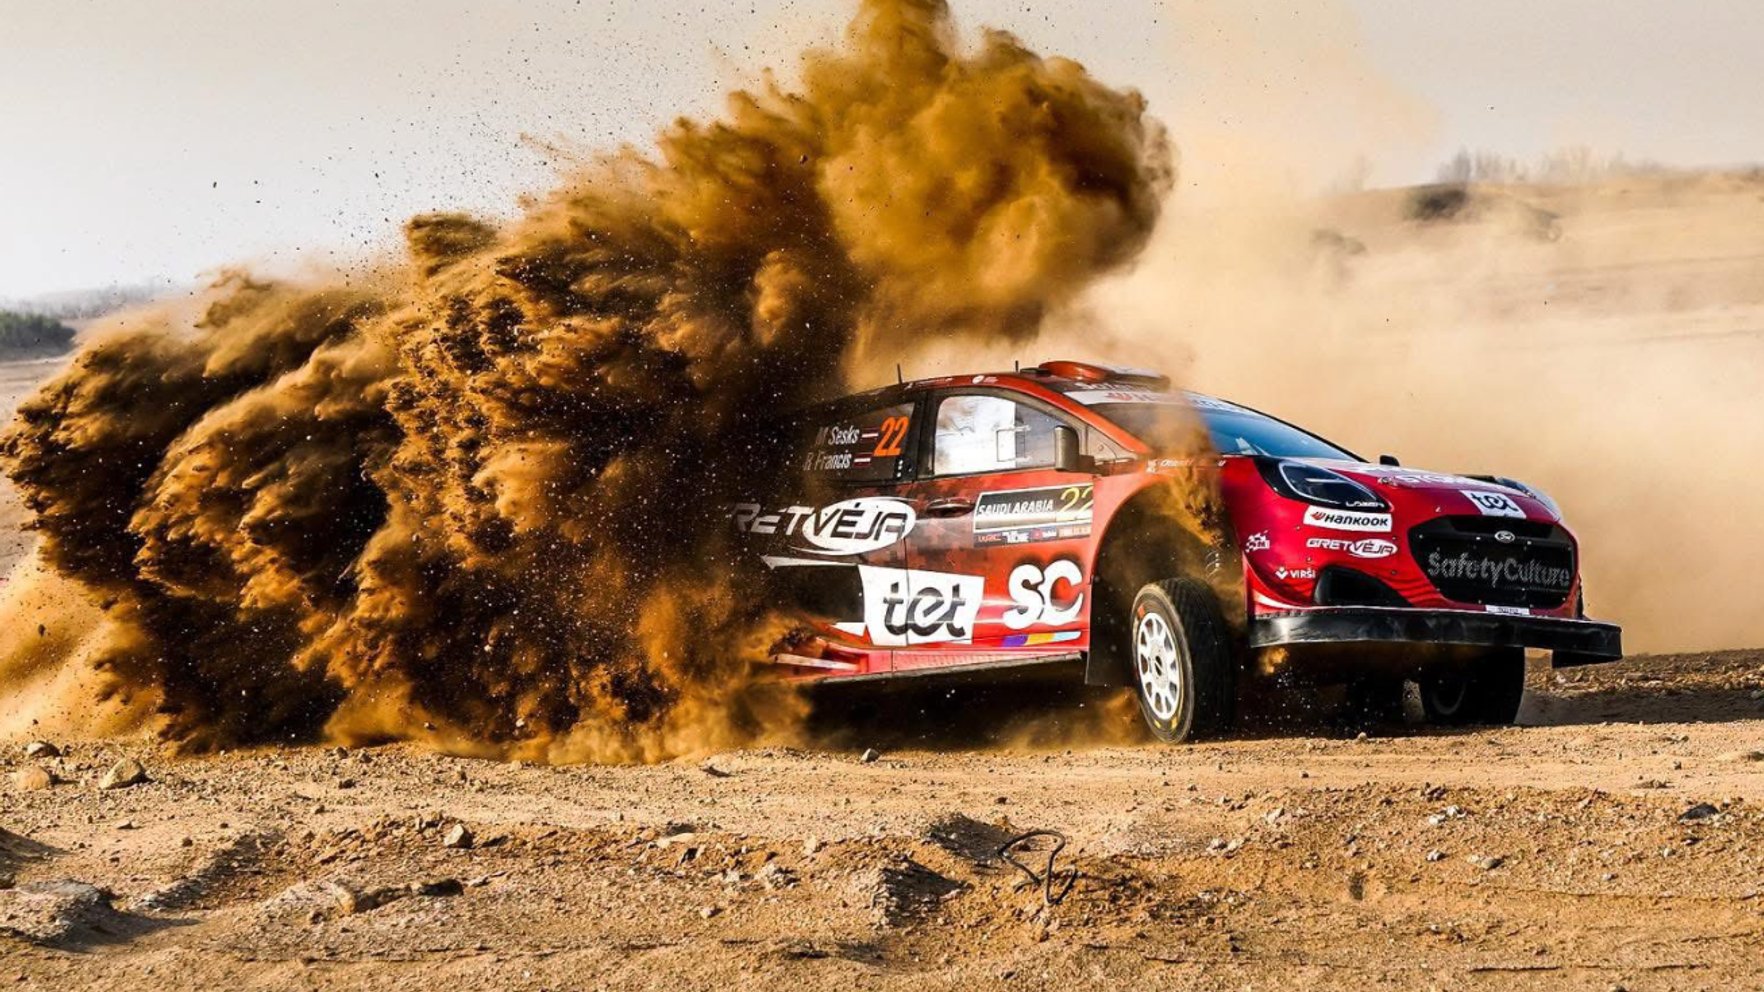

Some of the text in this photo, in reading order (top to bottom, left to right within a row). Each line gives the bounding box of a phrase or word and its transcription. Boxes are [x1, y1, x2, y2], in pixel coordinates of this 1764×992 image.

[828, 425, 860, 445] Sesks
[873, 416, 909, 456] 22
[814, 449, 852, 469] Francis
[978, 499, 1054, 516] SAUDI ARABIA
[1470, 492, 1519, 513] tet
[1427, 551, 1571, 588] SafetyCulture
[1002, 559, 1084, 630] SC
[883, 582, 966, 638] tet
